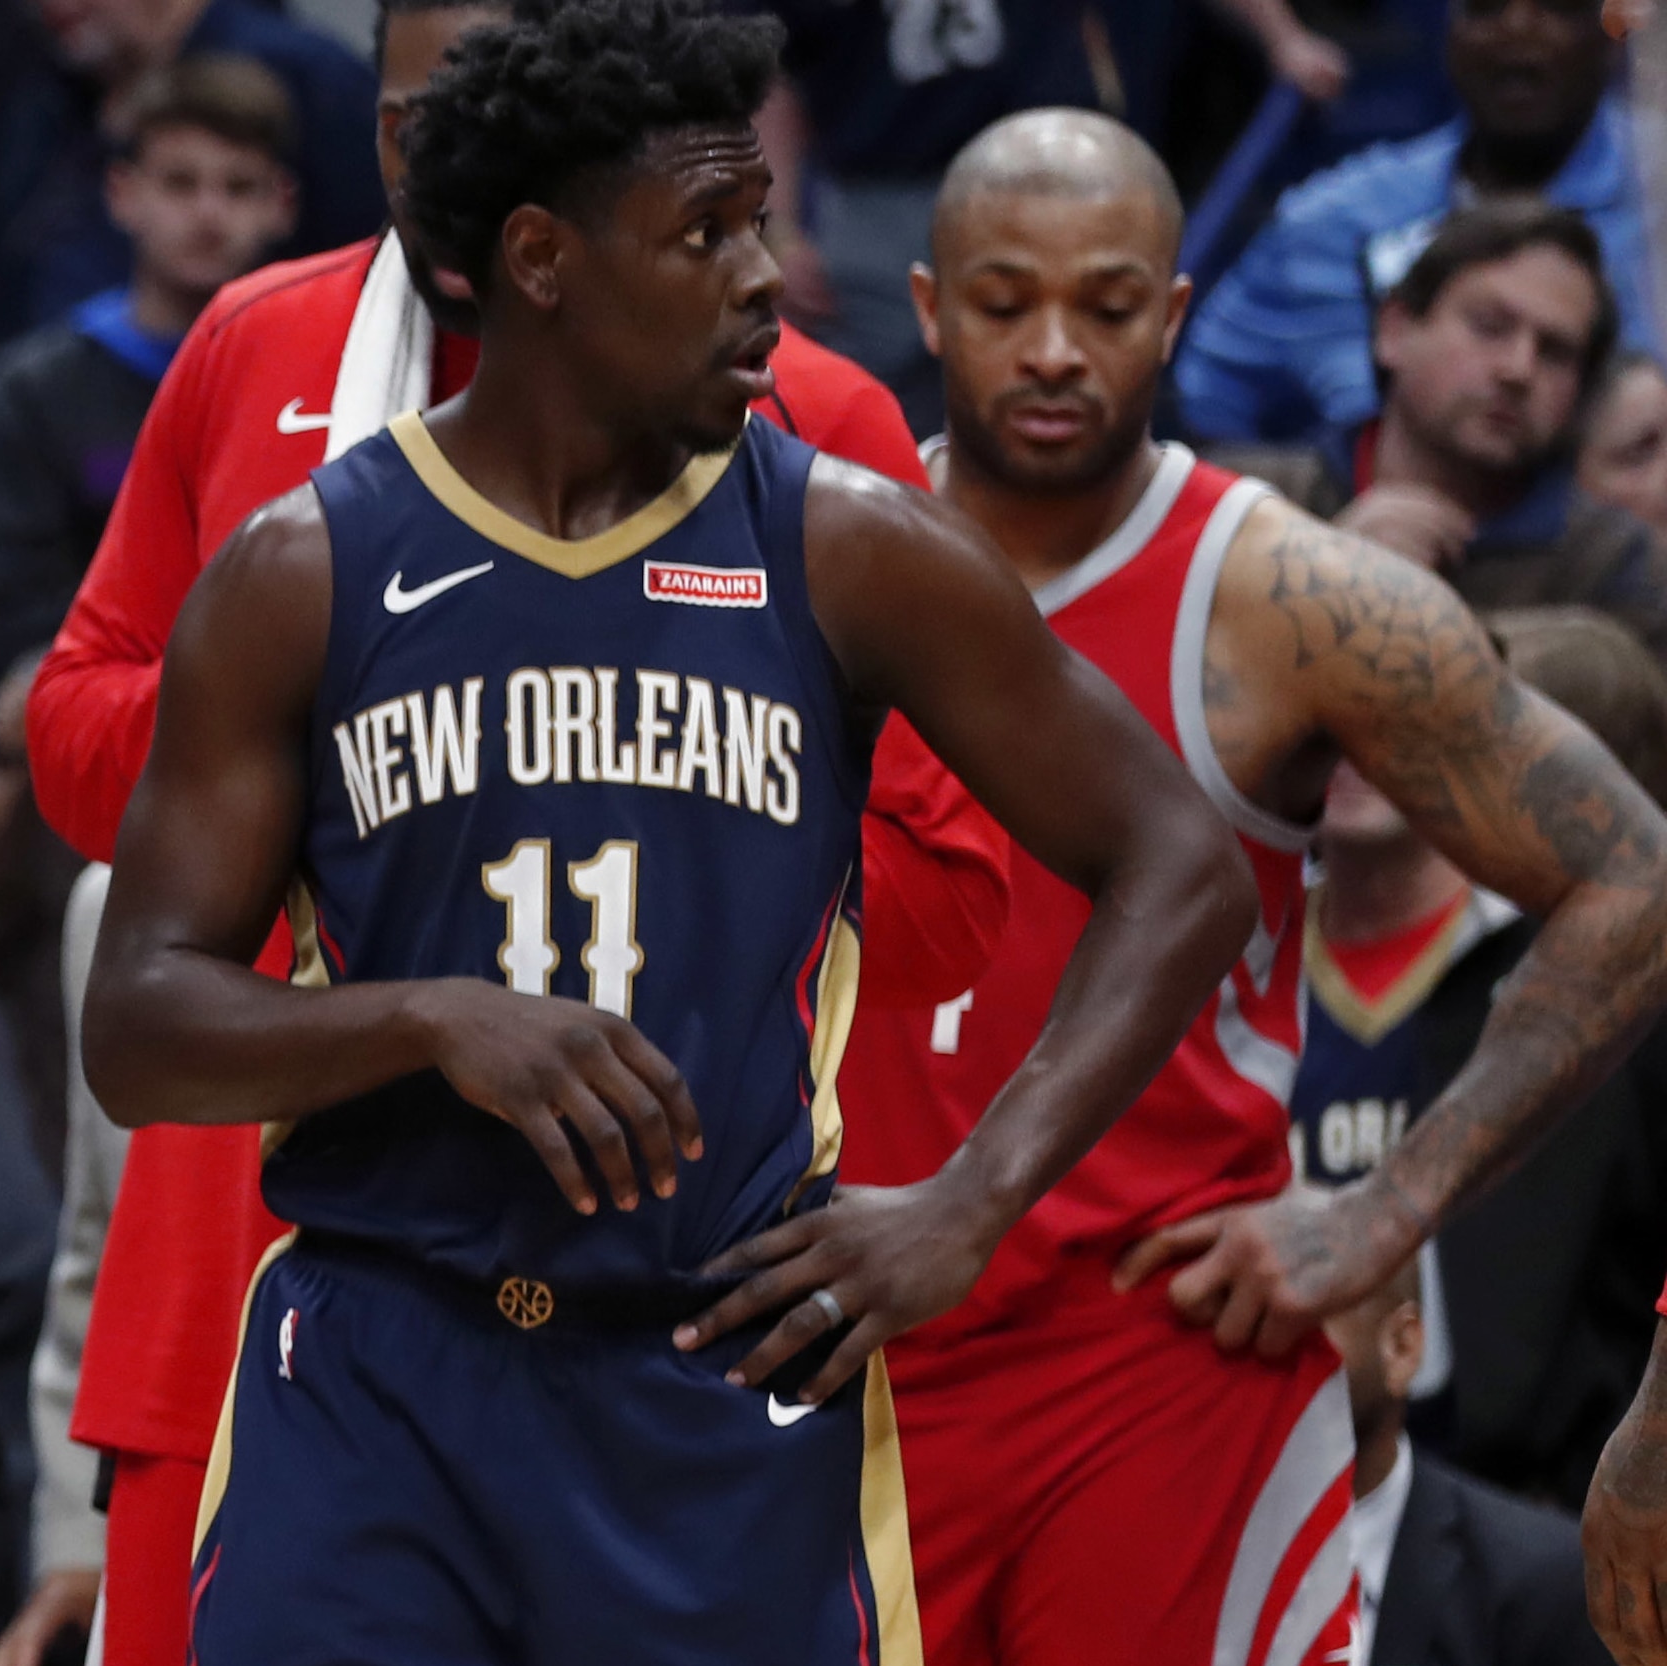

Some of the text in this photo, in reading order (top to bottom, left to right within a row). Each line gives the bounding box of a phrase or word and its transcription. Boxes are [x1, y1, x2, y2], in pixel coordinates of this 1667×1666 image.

[332, 666, 802, 840] NEW ORLEANS
[481, 838, 644, 1020] 11
